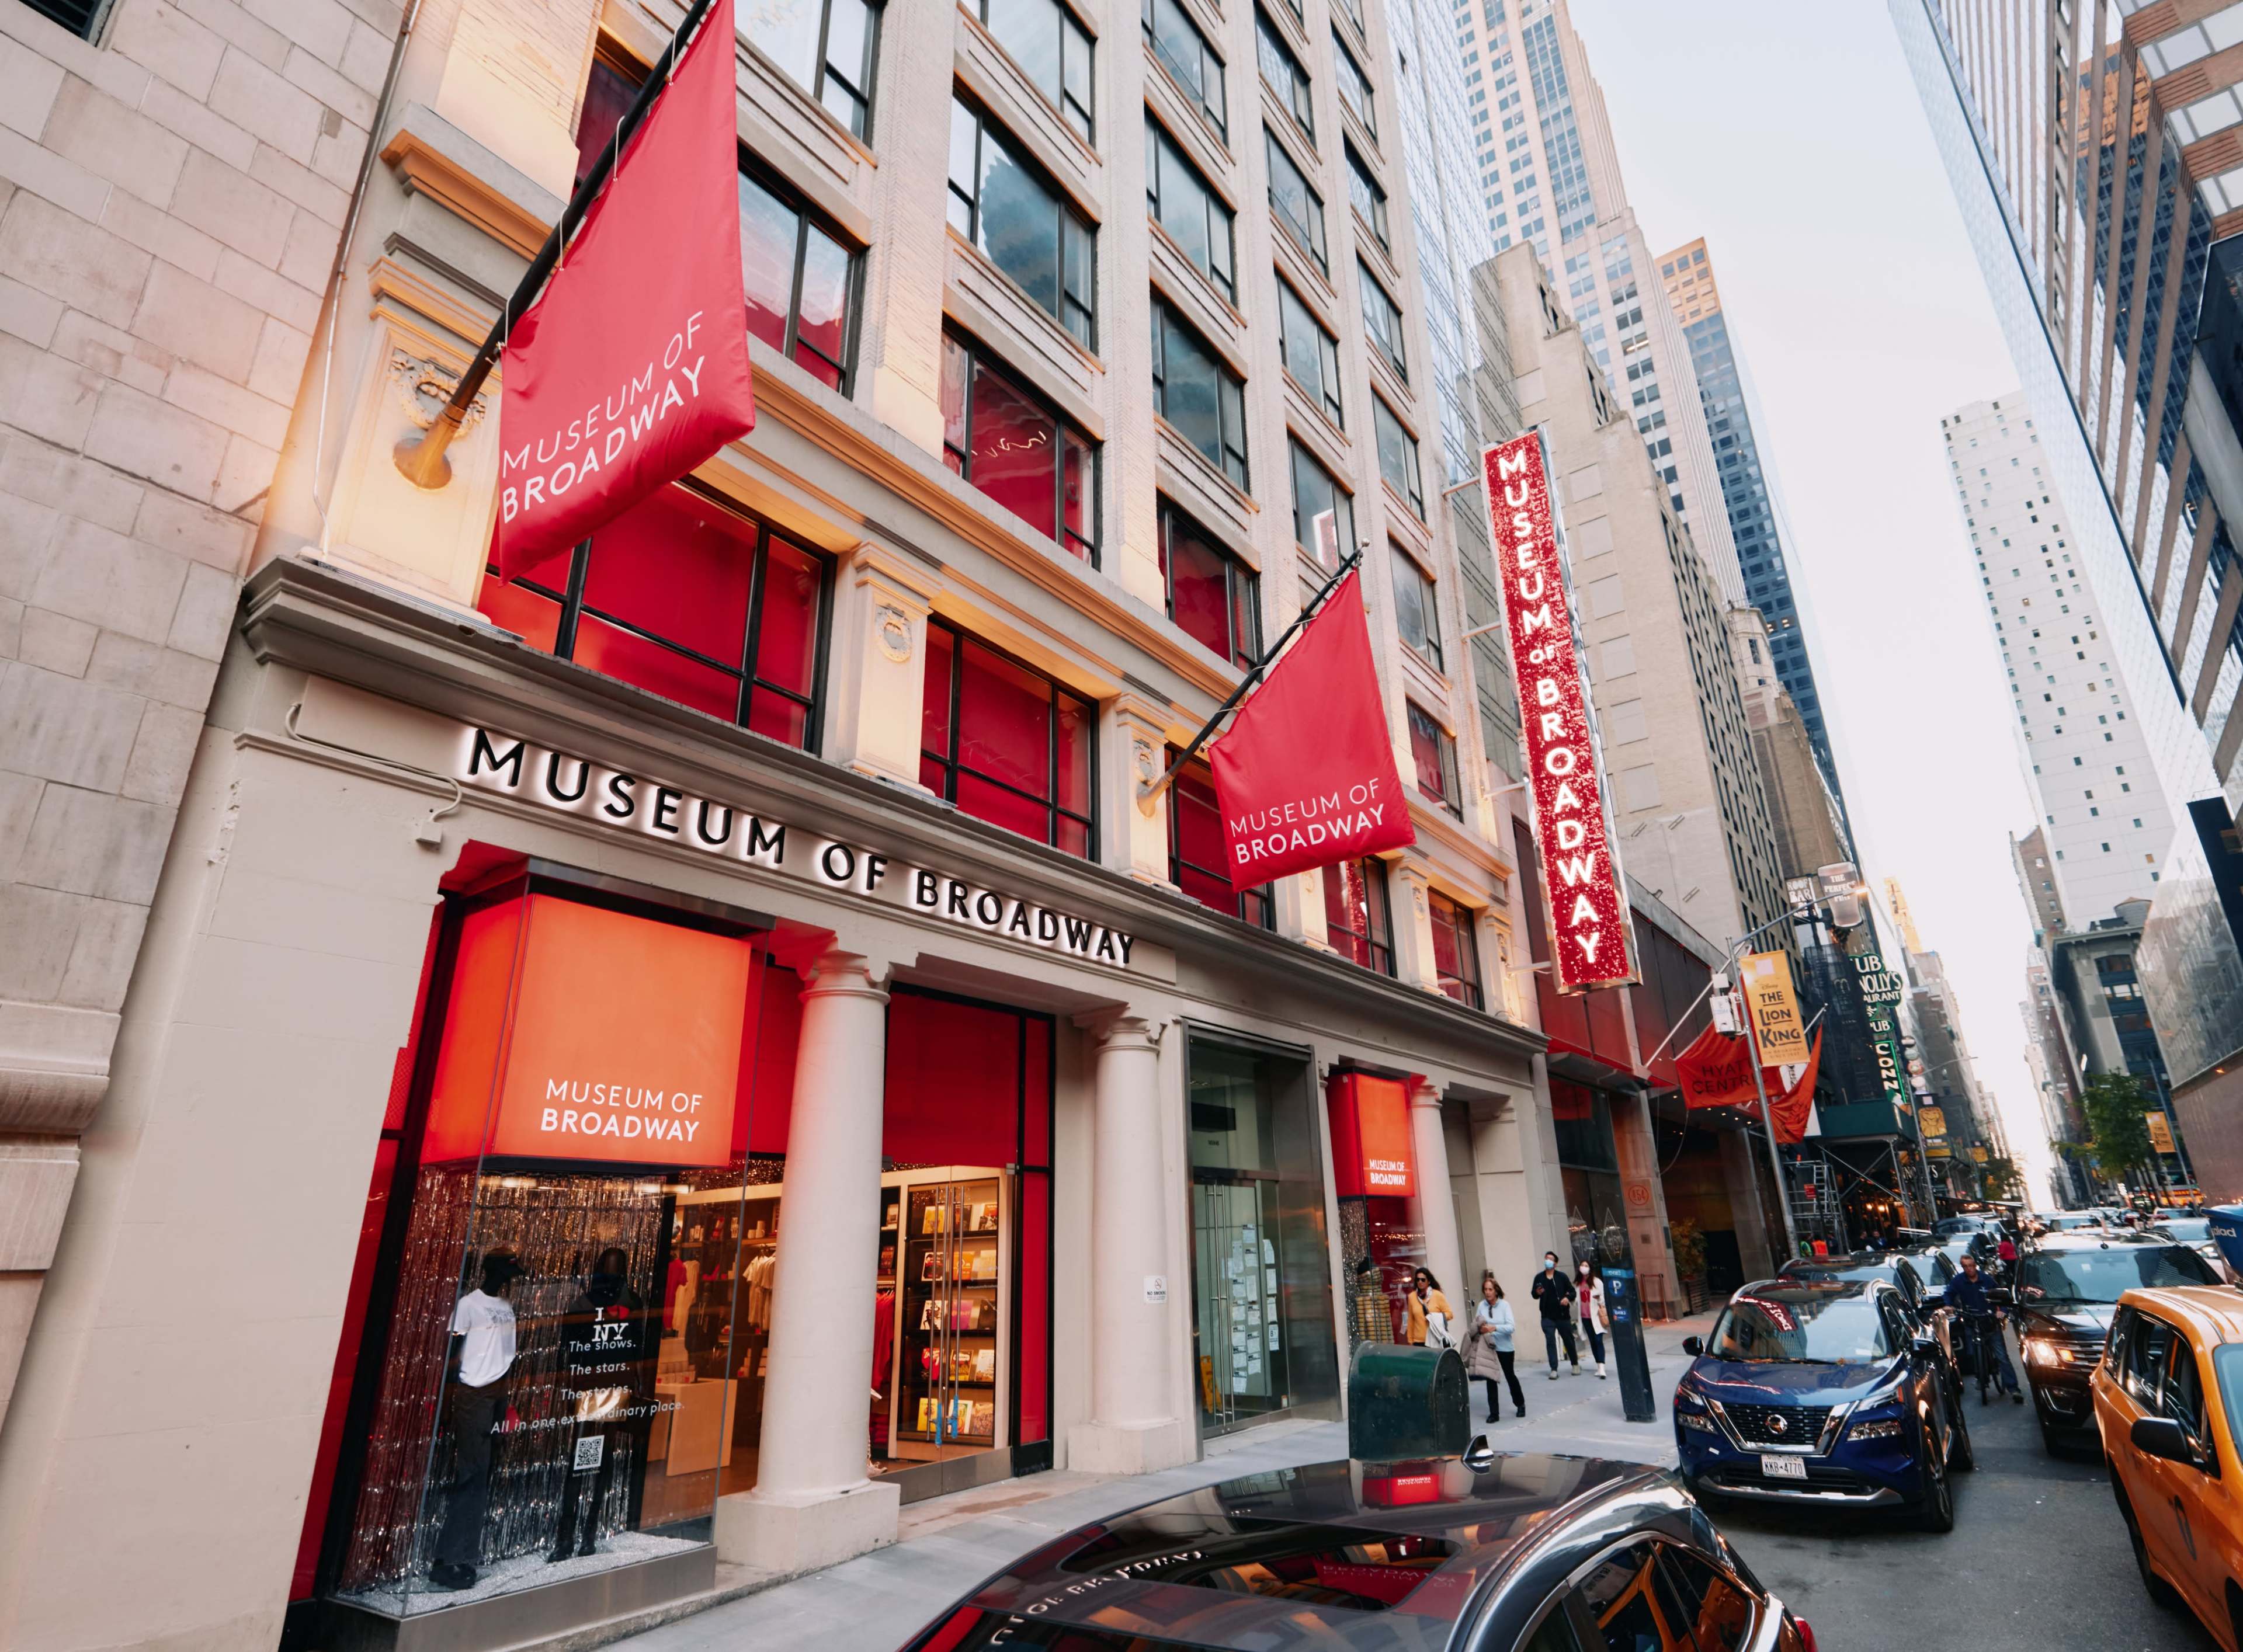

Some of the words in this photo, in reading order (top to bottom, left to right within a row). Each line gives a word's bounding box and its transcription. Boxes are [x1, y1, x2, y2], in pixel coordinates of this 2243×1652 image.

[502, 362, 654, 478] MUSEUM
[664, 310, 703, 370] OF
[502, 356, 705, 523] BROADWAY
[1499, 449, 1551, 635] MUSEUM
[1529, 645, 1555, 664] OF
[1230, 792, 1341, 838] MUSEUM
[1349, 777, 1380, 805] OF
[1536, 678, 1600, 964] BROADWAY
[1235, 804, 1384, 865] BROADWAY
[467, 729, 786, 864] MUSEUM
[822, 844, 888, 891] OF
[916, 871, 1134, 964] BROADWAY
[1786, 878, 1808, 891] ROOF
[1830, 874, 1845, 883] THE
[1789, 888, 1813, 903] BAR
[1759, 991, 1784, 1003] THE
[1758, 1008, 1792, 1027] LION
[1759, 1028, 1801, 1049] KING
[546, 1079, 664, 1111] MUSEUM
[671, 1093, 703, 1114] OF
[540, 1108, 700, 1142] BROADWAY
[1369, 1159, 1397, 1171] MUSEUM
[1397, 1161, 1405, 1172] OF
[1370, 1173, 1406, 1186] BROADWAY
[592, 1322, 629, 1343] NY
[570, 1340, 591, 1353] The
[595, 1338, 637, 1350] shows.
[570, 1364, 592, 1376] The
[596, 1362, 630, 1373] stars.
[561, 1388, 583, 1401] The
[588, 1384, 633, 1397] stories.
[491, 1420, 509, 1434] All
[515, 1418, 526, 1431] in
[532, 1416, 556, 1429] one
[650, 1400, 685, 1415] place.
